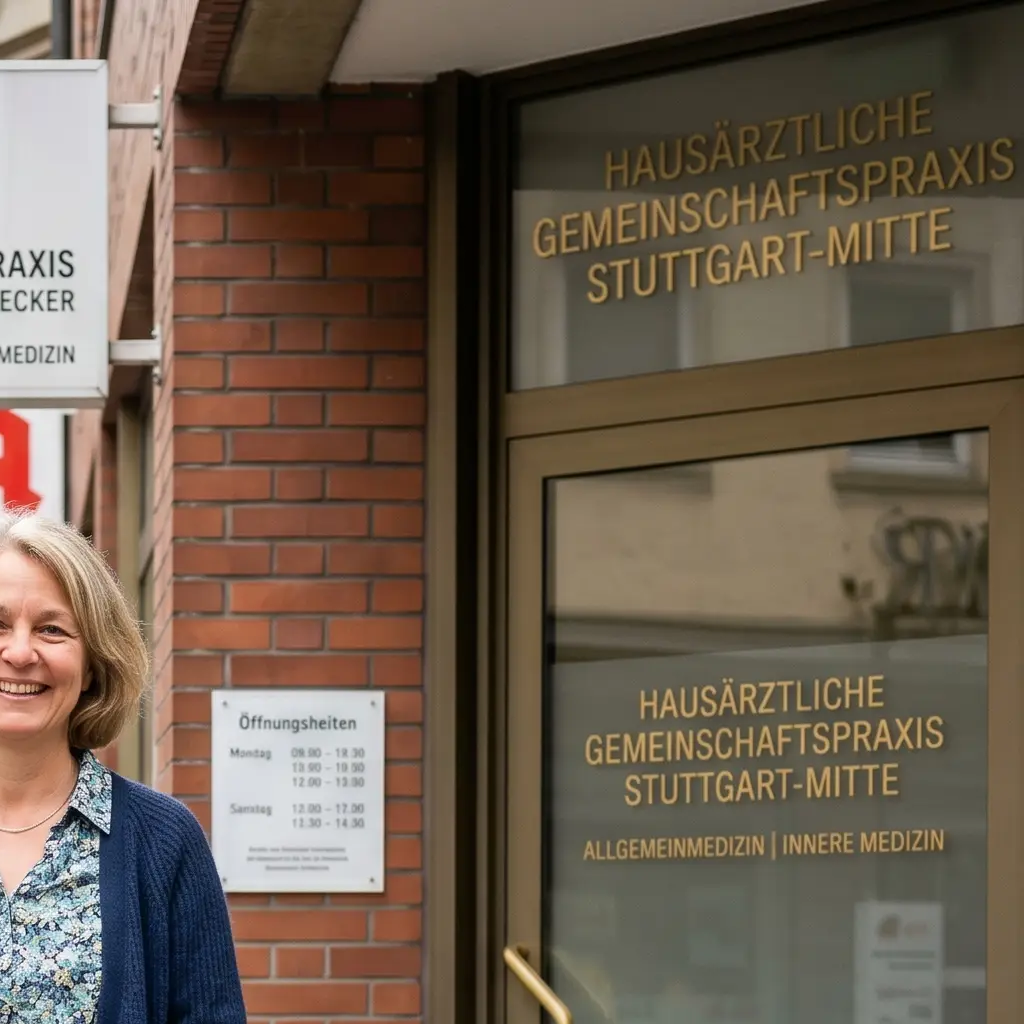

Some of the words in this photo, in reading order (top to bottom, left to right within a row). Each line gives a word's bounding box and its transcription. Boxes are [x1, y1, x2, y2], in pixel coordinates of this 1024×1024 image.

[605, 90, 934, 190] HAUSÄRZTLICHE
[532, 137, 1015, 258] GEMEINSCHAFTSPRAXIS
[586, 206, 953, 303] STUTTGART-MITTE
[639, 674, 885, 720] HAUSÄRZTLICHE
[239, 712, 357, 734] Öffnungsheiten
[584, 715, 945, 766] GEMEINSCHAFTSPRAXIS
[624, 762, 900, 807] STUTTGART-MITTE
[583, 835, 765, 861] ALLGEMEINMEDIZIN
[782, 832, 854, 855] INNERE
[860, 828, 944, 852] MEDIZIN
